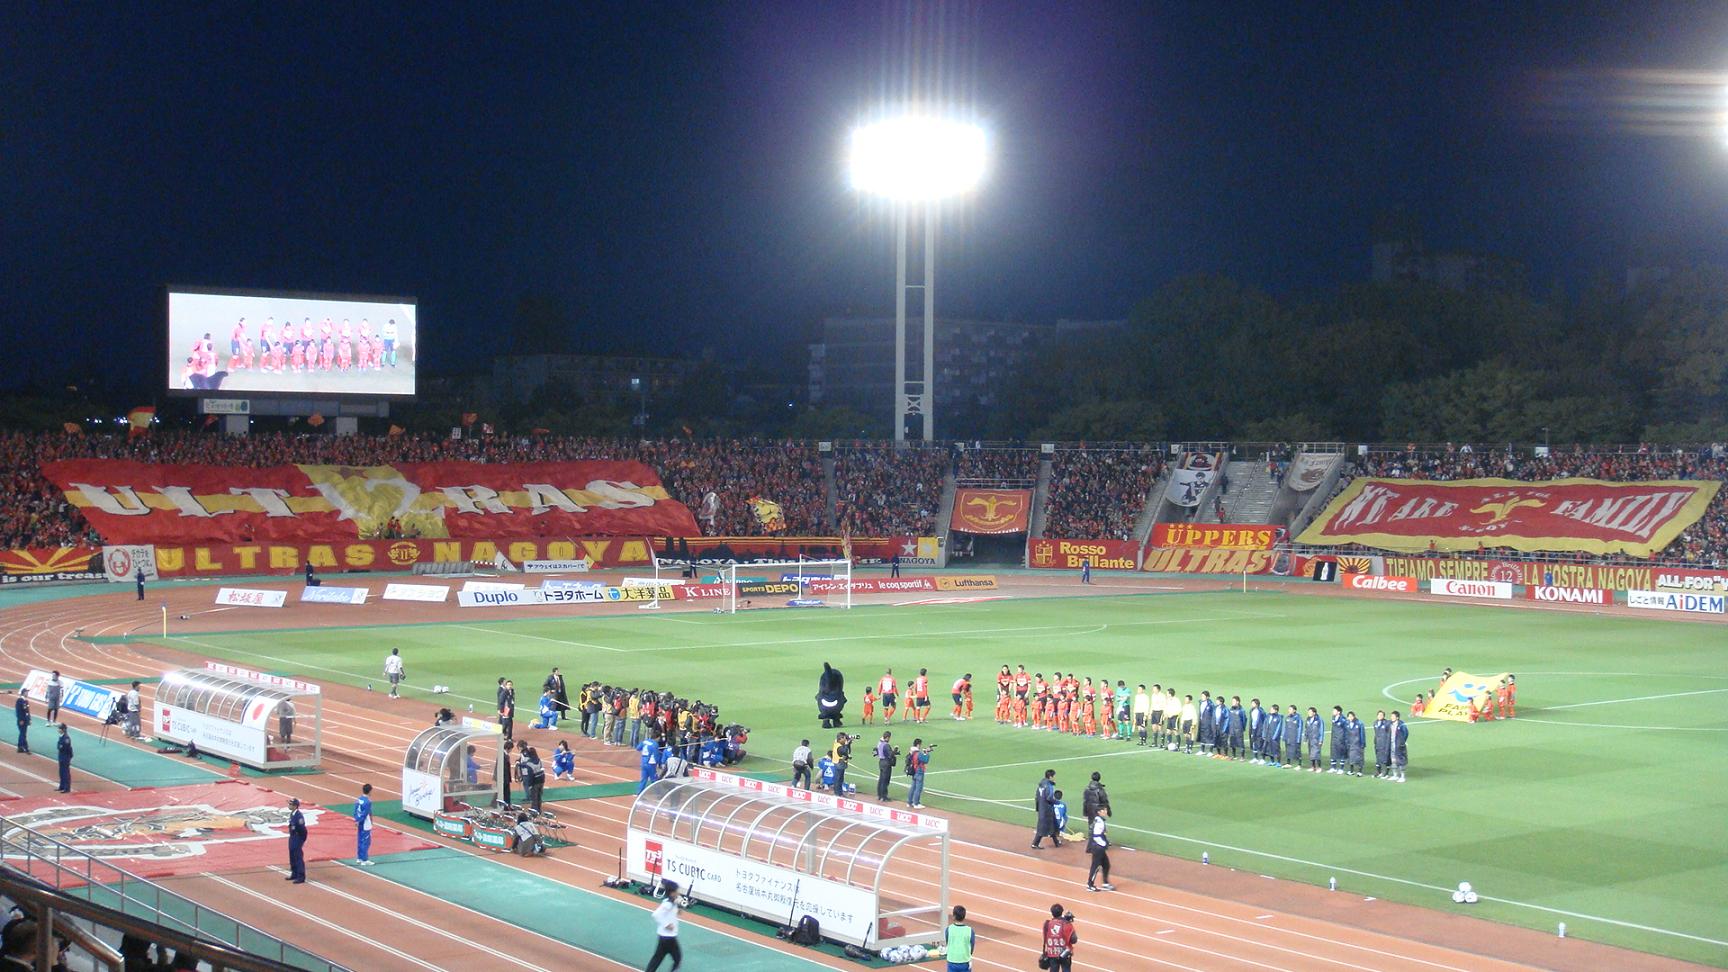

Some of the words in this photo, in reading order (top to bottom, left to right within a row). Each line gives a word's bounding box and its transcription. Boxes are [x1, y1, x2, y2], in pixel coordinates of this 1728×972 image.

[433, 541, 647, 563] NAGOYA
[1059, 541, 1106, 555] Rosso
[156, 544, 375, 572] ULTRAS
[900, 557, 936, 565] NAGOYA
[1143, 549, 1275, 573] ULTRAS
[1440, 560, 1487, 582] SEMPRE
[1501, 570, 1513, 582] 12
[1524, 564, 1539, 586] LA
[1598, 566, 1651, 591] NAGOYA
[2, 575, 17, 584] is
[21, 574, 54, 582] our
[886, 582, 900, 590] coq
[900, 580, 922, 589] sportif
[955, 579, 993, 588] Lufthansa
[1352, 575, 1407, 591] Calbee
[1658, 574, 1684, 588] ALL
[1685, 576, 1714, 590] FOR
[622, 587, 671, 600] 大洋薬品
[702, 588, 731, 597] LINE
[766, 583, 799, 595] DEPO
[1445, 580, 1496, 597] Canon
[1534, 586, 1603, 604] KONAMI
[474, 590, 518, 605] Duplo
[543, 590, 604, 602] トヨタホーム
[1666, 594, 1723, 613] AiDEM
[792, 789, 806, 800] UCC
[869, 806, 884, 816] UCC
[896, 811, 912, 823] UCC
[667, 859, 677, 872] TS
[679, 863, 706, 881] CUBIC
[707, 872, 722, 883] CARD
